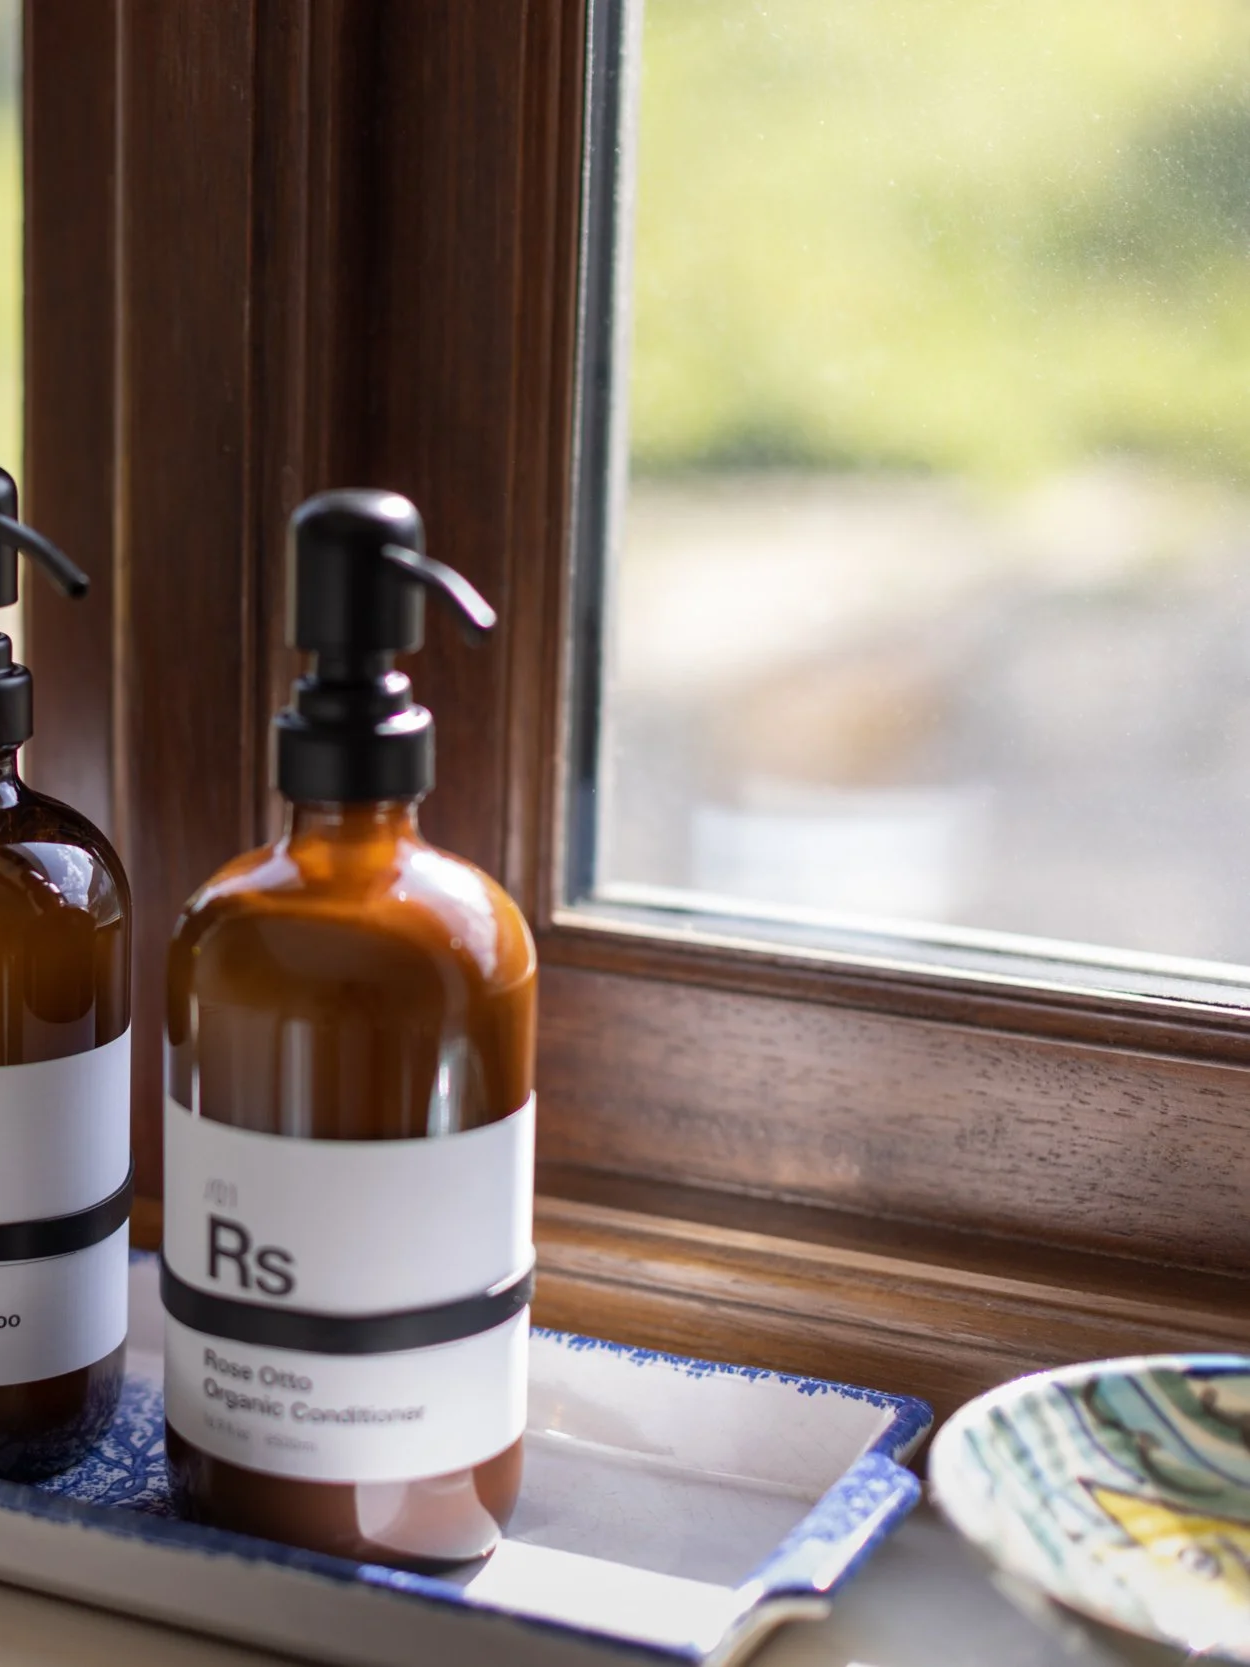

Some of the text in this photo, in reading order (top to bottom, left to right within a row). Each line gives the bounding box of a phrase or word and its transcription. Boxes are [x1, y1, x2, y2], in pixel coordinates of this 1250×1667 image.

[208, 1213, 296, 1296] Rs
[203, 1347, 313, 1393] Rose Otto
[203, 1376, 285, 1418] Organic
[290, 1400, 425, 1426] Conditioner
